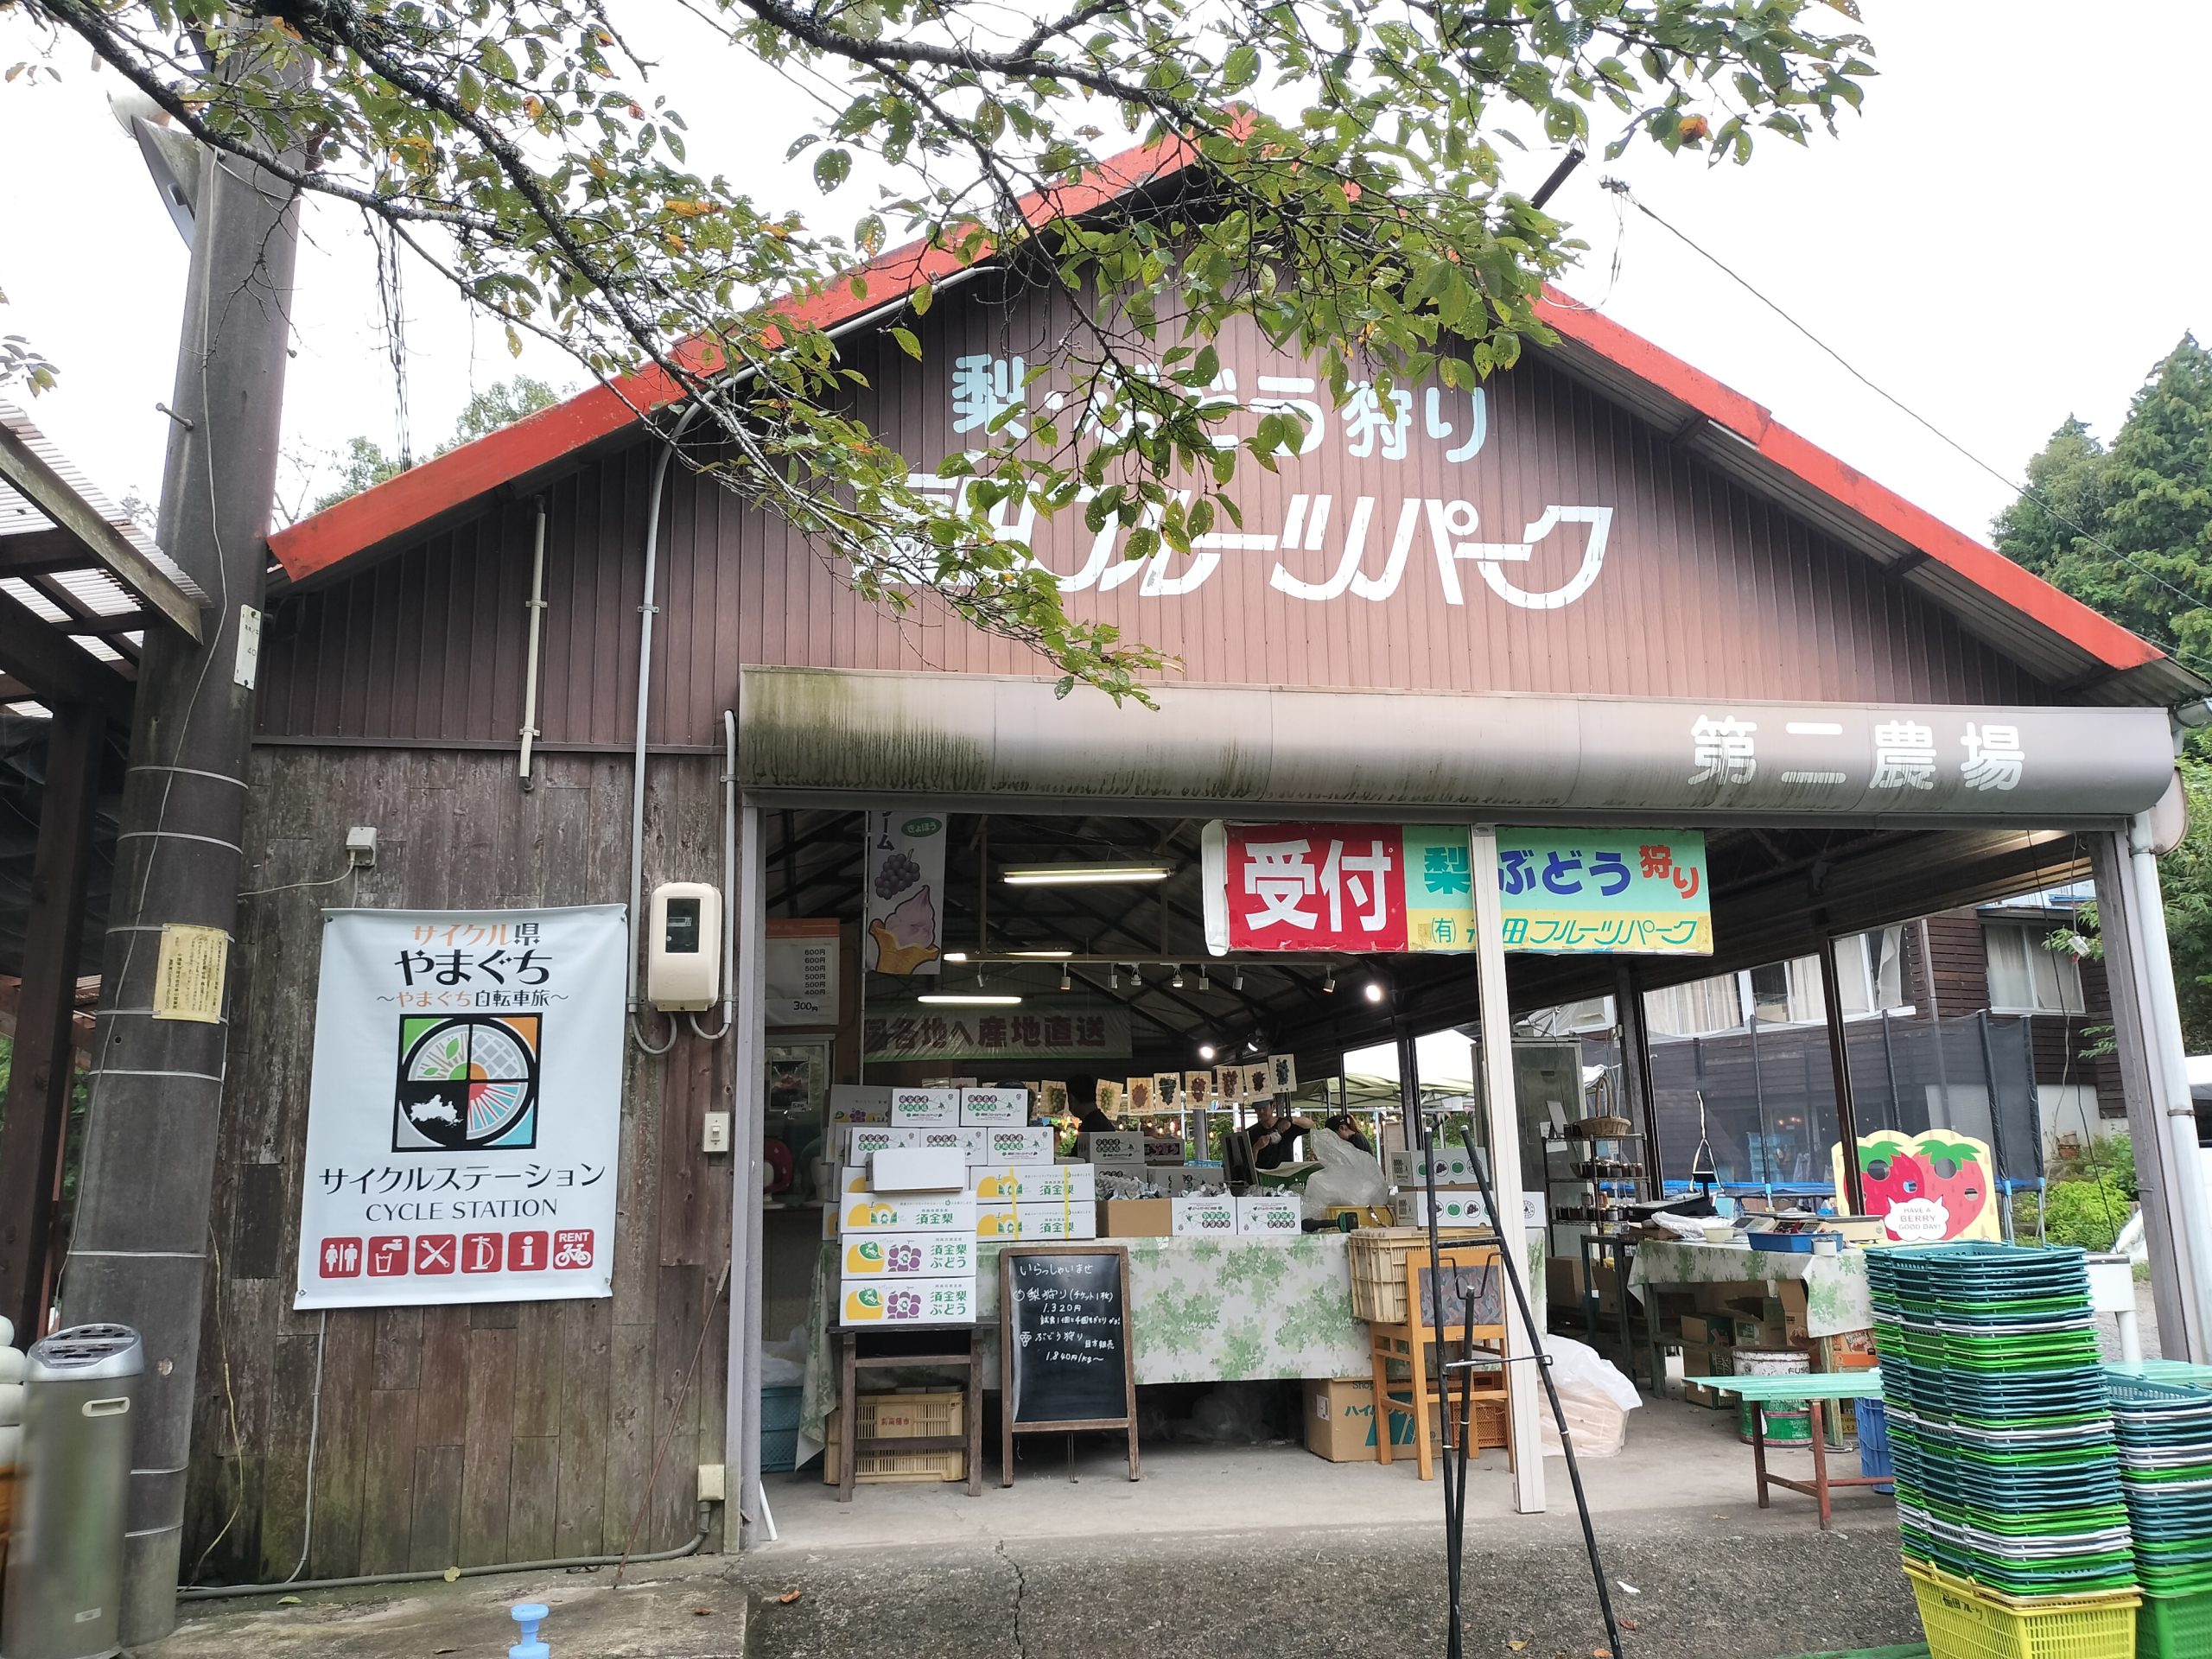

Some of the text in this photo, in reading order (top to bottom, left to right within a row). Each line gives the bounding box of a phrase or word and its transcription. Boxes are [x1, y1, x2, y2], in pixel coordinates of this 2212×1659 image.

[1688, 715, 2025, 792] 第二農場
[906, 822, 938, 834] きょほう
[1243, 837, 1394, 932] 受付
[411, 922, 540, 947] サイクル県
[1466, 918, 1698, 946] 田フルーツパーク
[394, 949, 553, 987] やまぐち
[793, 1001, 818, 1012] 300円
[319, 1162, 606, 1195] サイクルステーション
[365, 1198, 558, 1223] CYCLE STATION
[915, 1212, 954, 1225] 須金梨
[559, 1232, 589, 1243] RENT
[930, 1243, 967, 1255] 須金梨
[930, 1256, 967, 1268] ぶどう
[1020, 1262, 1094, 1276] いらっしゃいませ
[930, 1290, 967, 1302] 須金梨
[930, 1304, 967, 1316] ぶどう
[1034, 1330, 1084, 1342] ぶどう狩り
